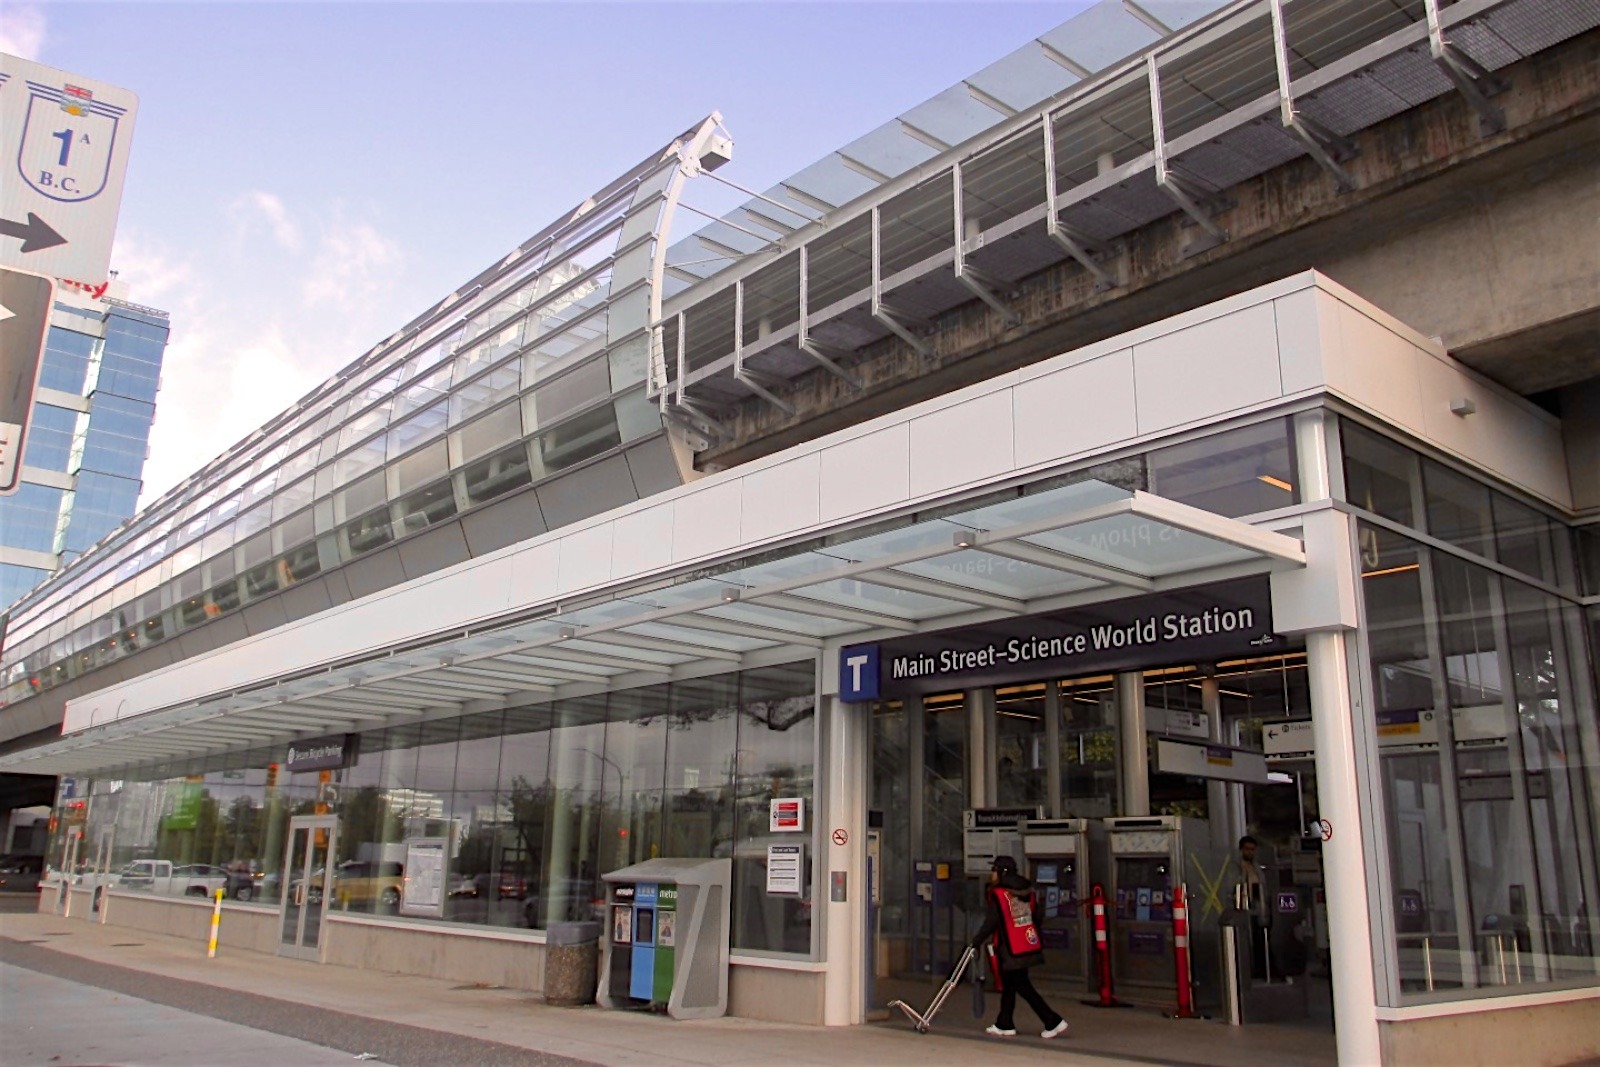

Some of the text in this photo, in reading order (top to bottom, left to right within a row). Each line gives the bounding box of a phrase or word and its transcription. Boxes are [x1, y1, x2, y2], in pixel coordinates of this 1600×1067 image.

[38, 170, 81, 194] B.C.
[893, 653, 935, 679] Main
[1091, 617, 1157, 650] World
[1163, 607, 1253, 640] Station
[847, 655, 868, 692] T
